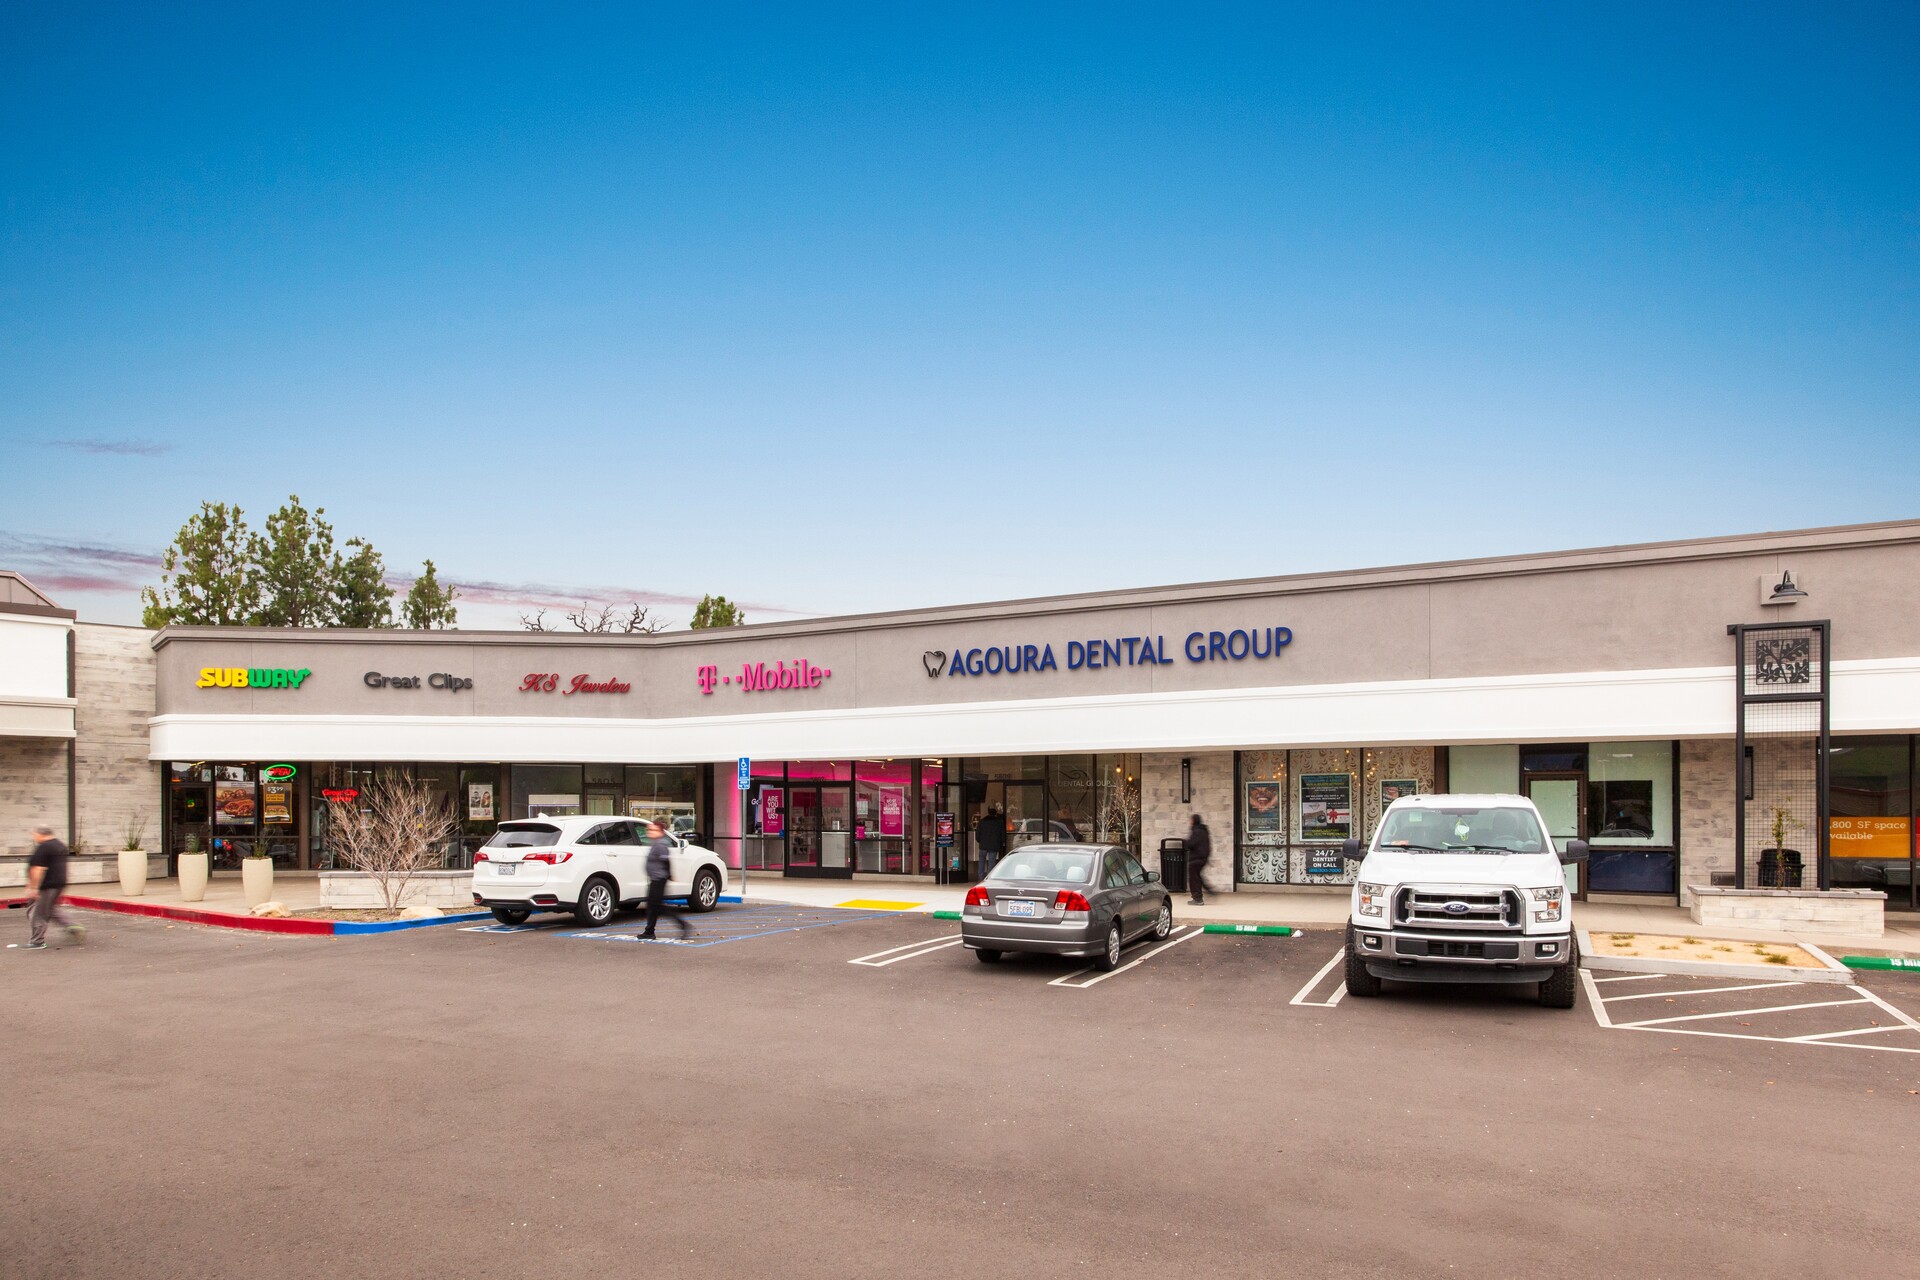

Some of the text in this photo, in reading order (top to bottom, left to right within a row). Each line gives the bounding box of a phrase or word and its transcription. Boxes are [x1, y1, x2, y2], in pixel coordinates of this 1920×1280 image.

[948, 626, 1293, 677] AGOURA DENTAL GROUP
[195, 667, 312, 689] SUBWAY
[363, 671, 473, 693] Great Clips
[518, 673, 632, 696] KS Jewelers
[1829, 820, 1906, 831] ,800 SF space
[1829, 831, 1873, 840] vailable
[1315, 849, 1335, 857] 24/7
[1889, 958, 1902, 966] 15
